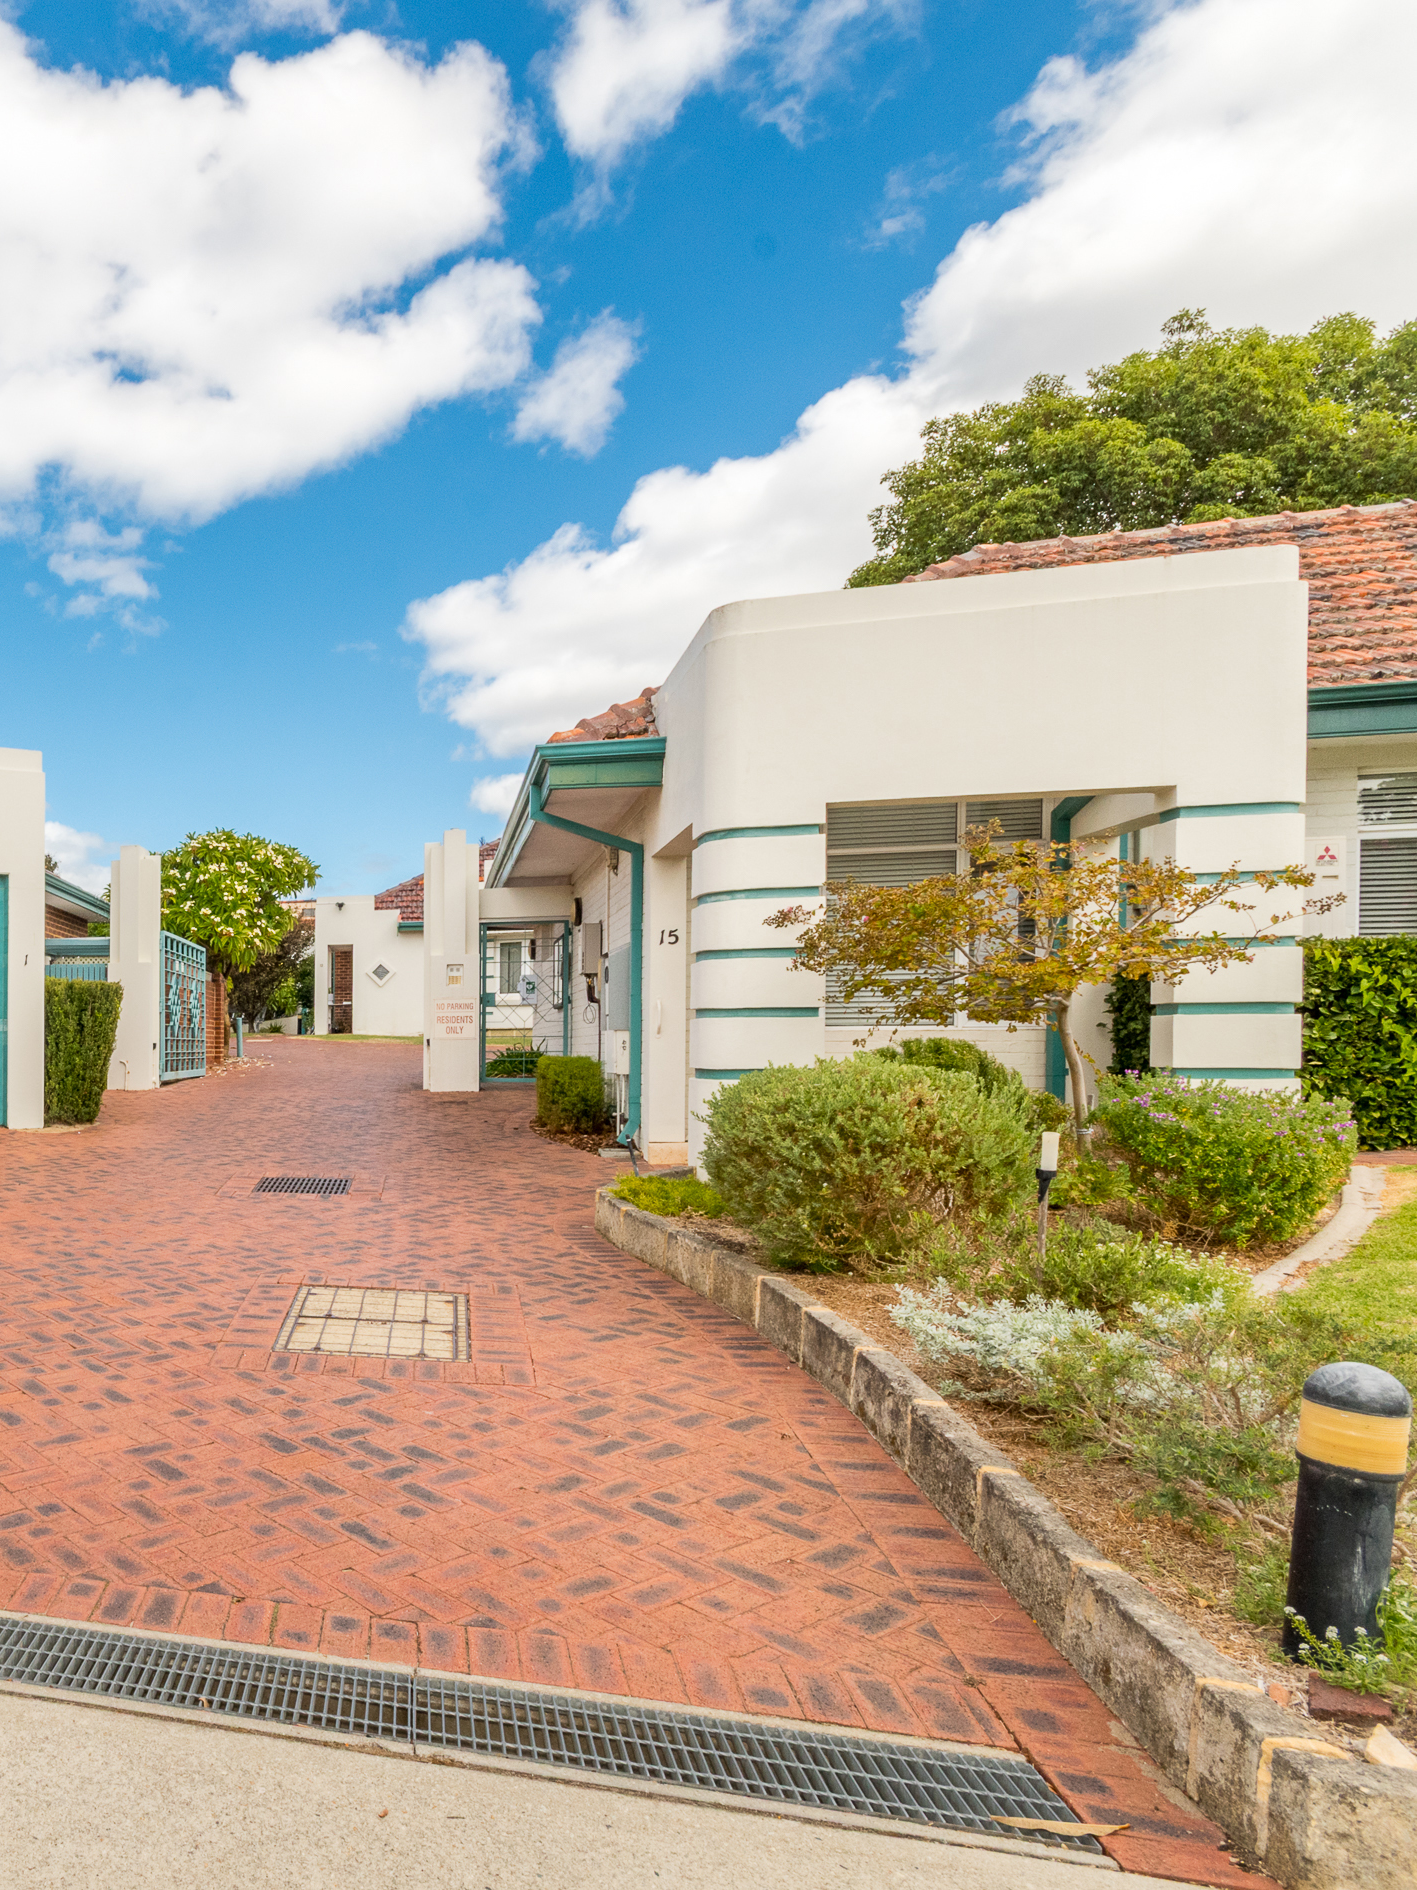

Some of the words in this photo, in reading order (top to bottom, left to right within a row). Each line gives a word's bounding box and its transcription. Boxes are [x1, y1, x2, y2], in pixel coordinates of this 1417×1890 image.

[659, 928, 680, 946] 15
[436, 1015, 474, 1024] RESIDENTS
[445, 1026, 464, 1034] ONLY
